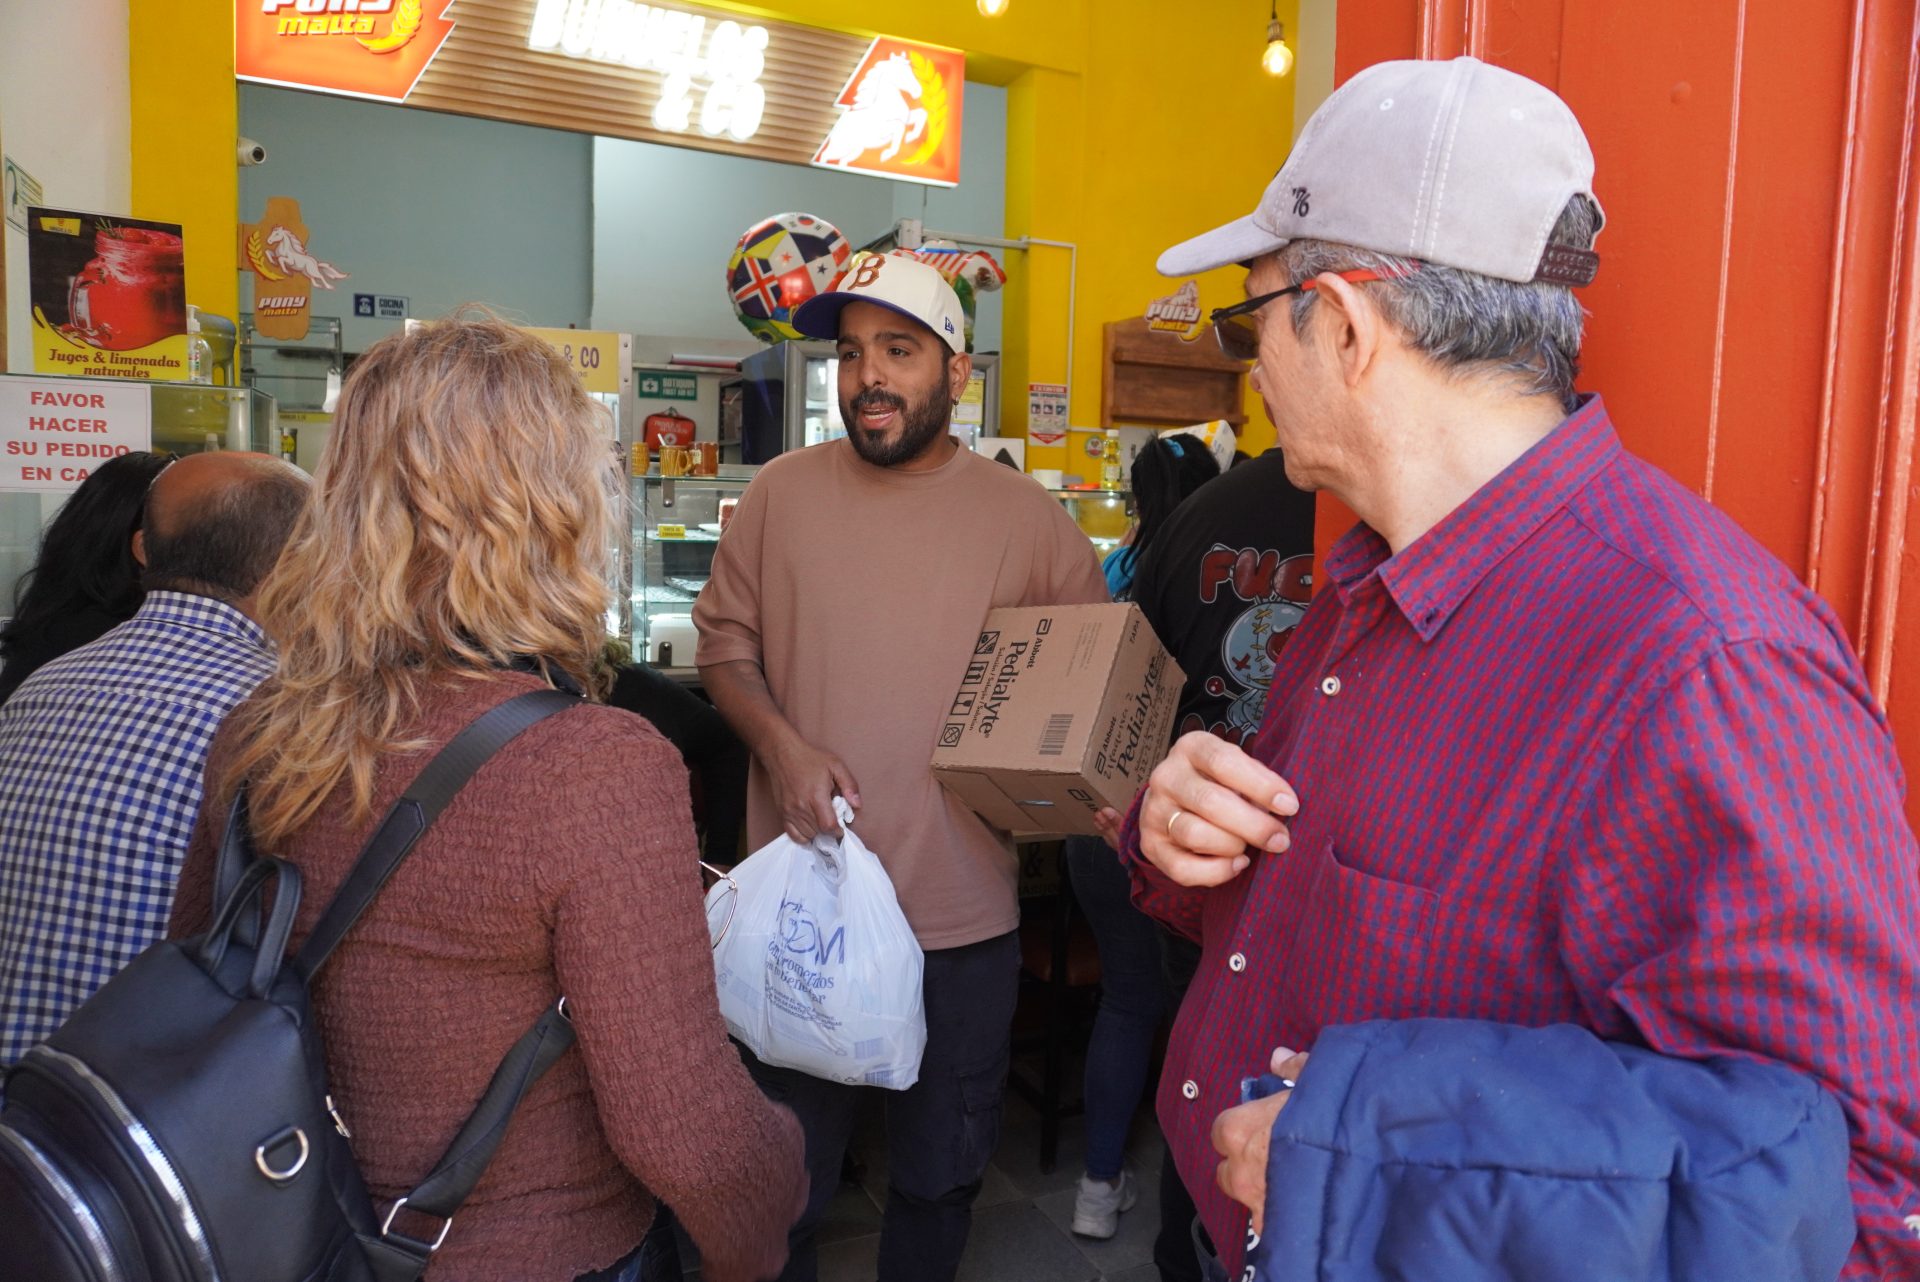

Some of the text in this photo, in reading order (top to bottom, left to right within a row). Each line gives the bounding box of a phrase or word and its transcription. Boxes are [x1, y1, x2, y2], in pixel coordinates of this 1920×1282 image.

[276, 15, 376, 35] malta
[847, 253, 886, 291] B
[258, 296, 307, 310] PONY
[263, 308, 299, 317] malta
[1147, 303, 1201, 323] PONY
[49, 349, 181, 368] Jugos & limonadas
[580, 346, 600, 369] CO
[83, 365, 150, 379] naturales
[30, 390, 106, 409] FAVOR
[28, 416, 109, 434] HACER
[6, 440, 131, 458] SU PEDIDO
[21, 466, 90, 482] EN CA
[1026, 637, 1043, 669] Abbott
[1102, 715, 1117, 752] Abbott
